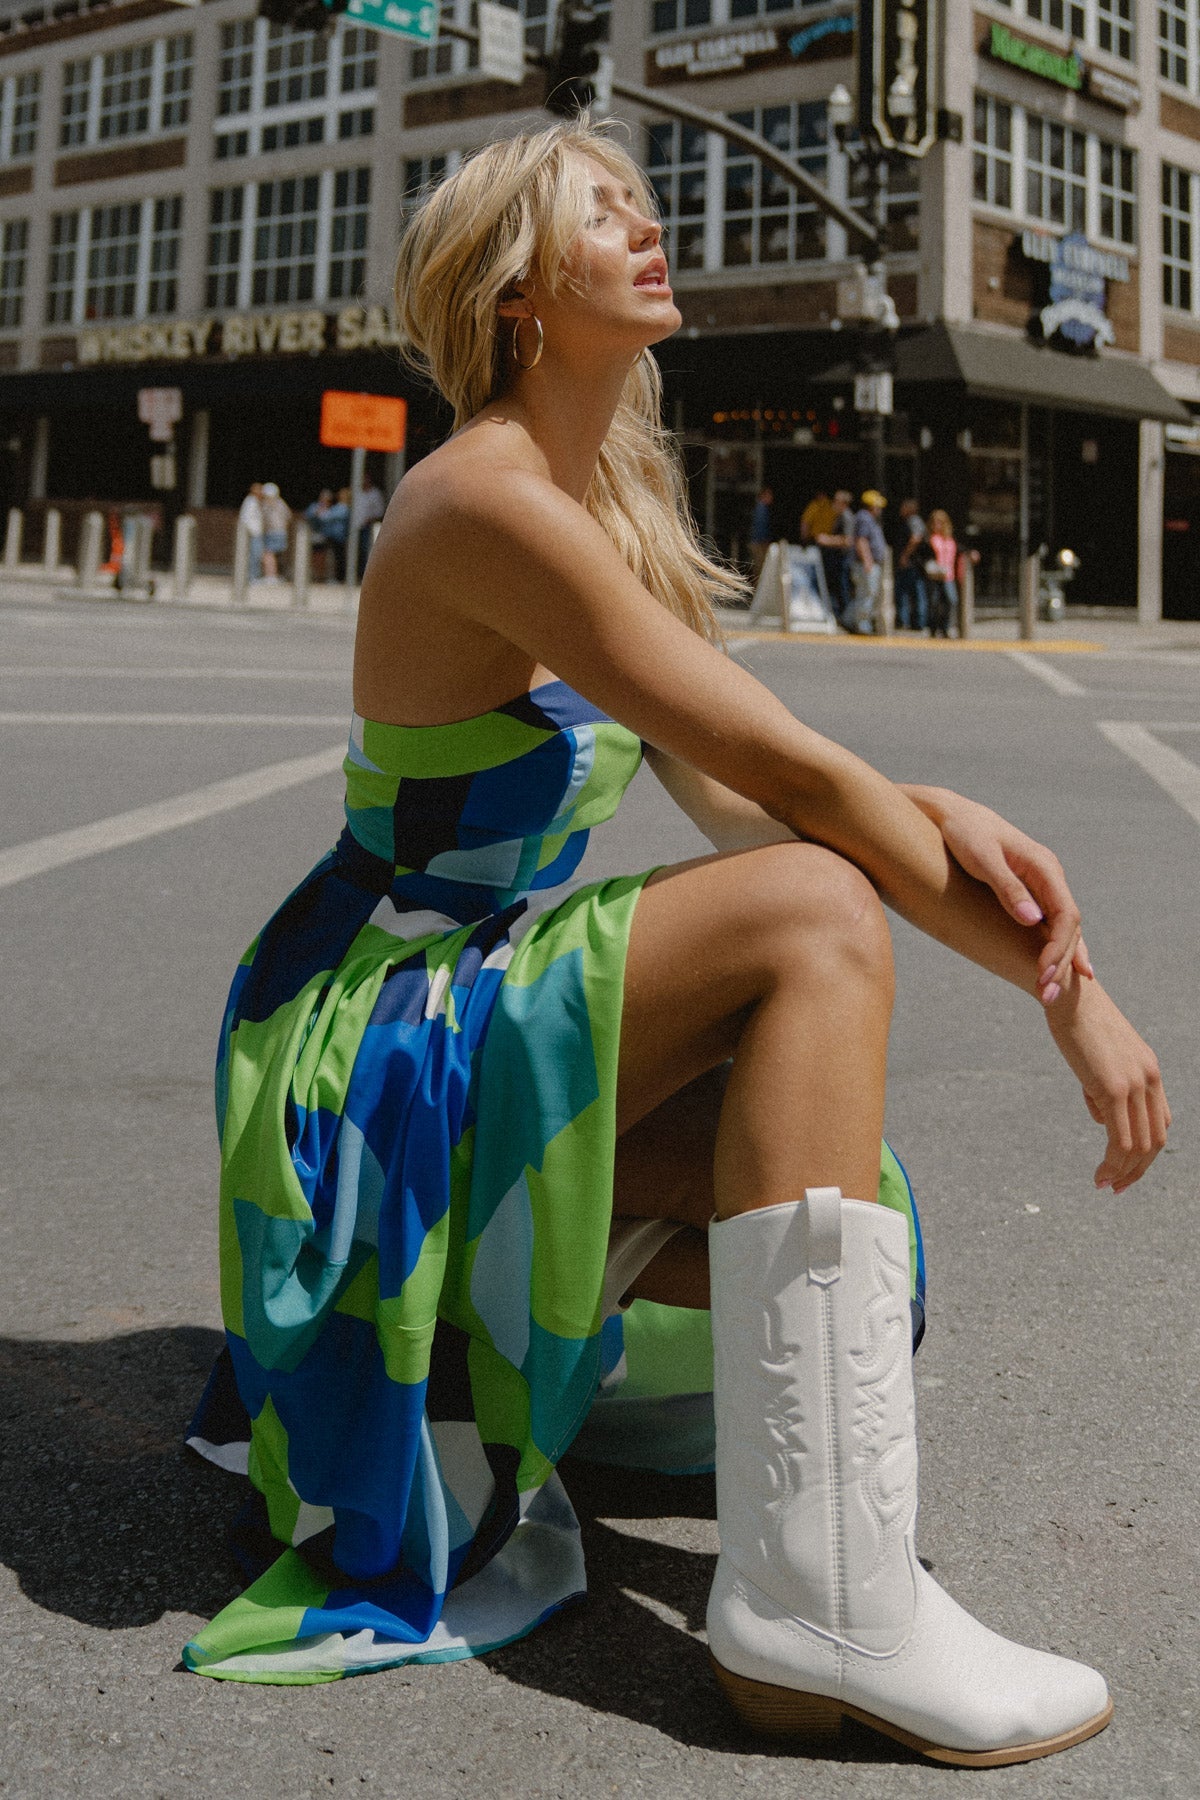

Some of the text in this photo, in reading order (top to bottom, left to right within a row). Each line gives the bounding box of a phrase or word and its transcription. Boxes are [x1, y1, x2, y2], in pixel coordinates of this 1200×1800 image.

[78, 304, 407, 363] WHISKEY RIVER SAL
